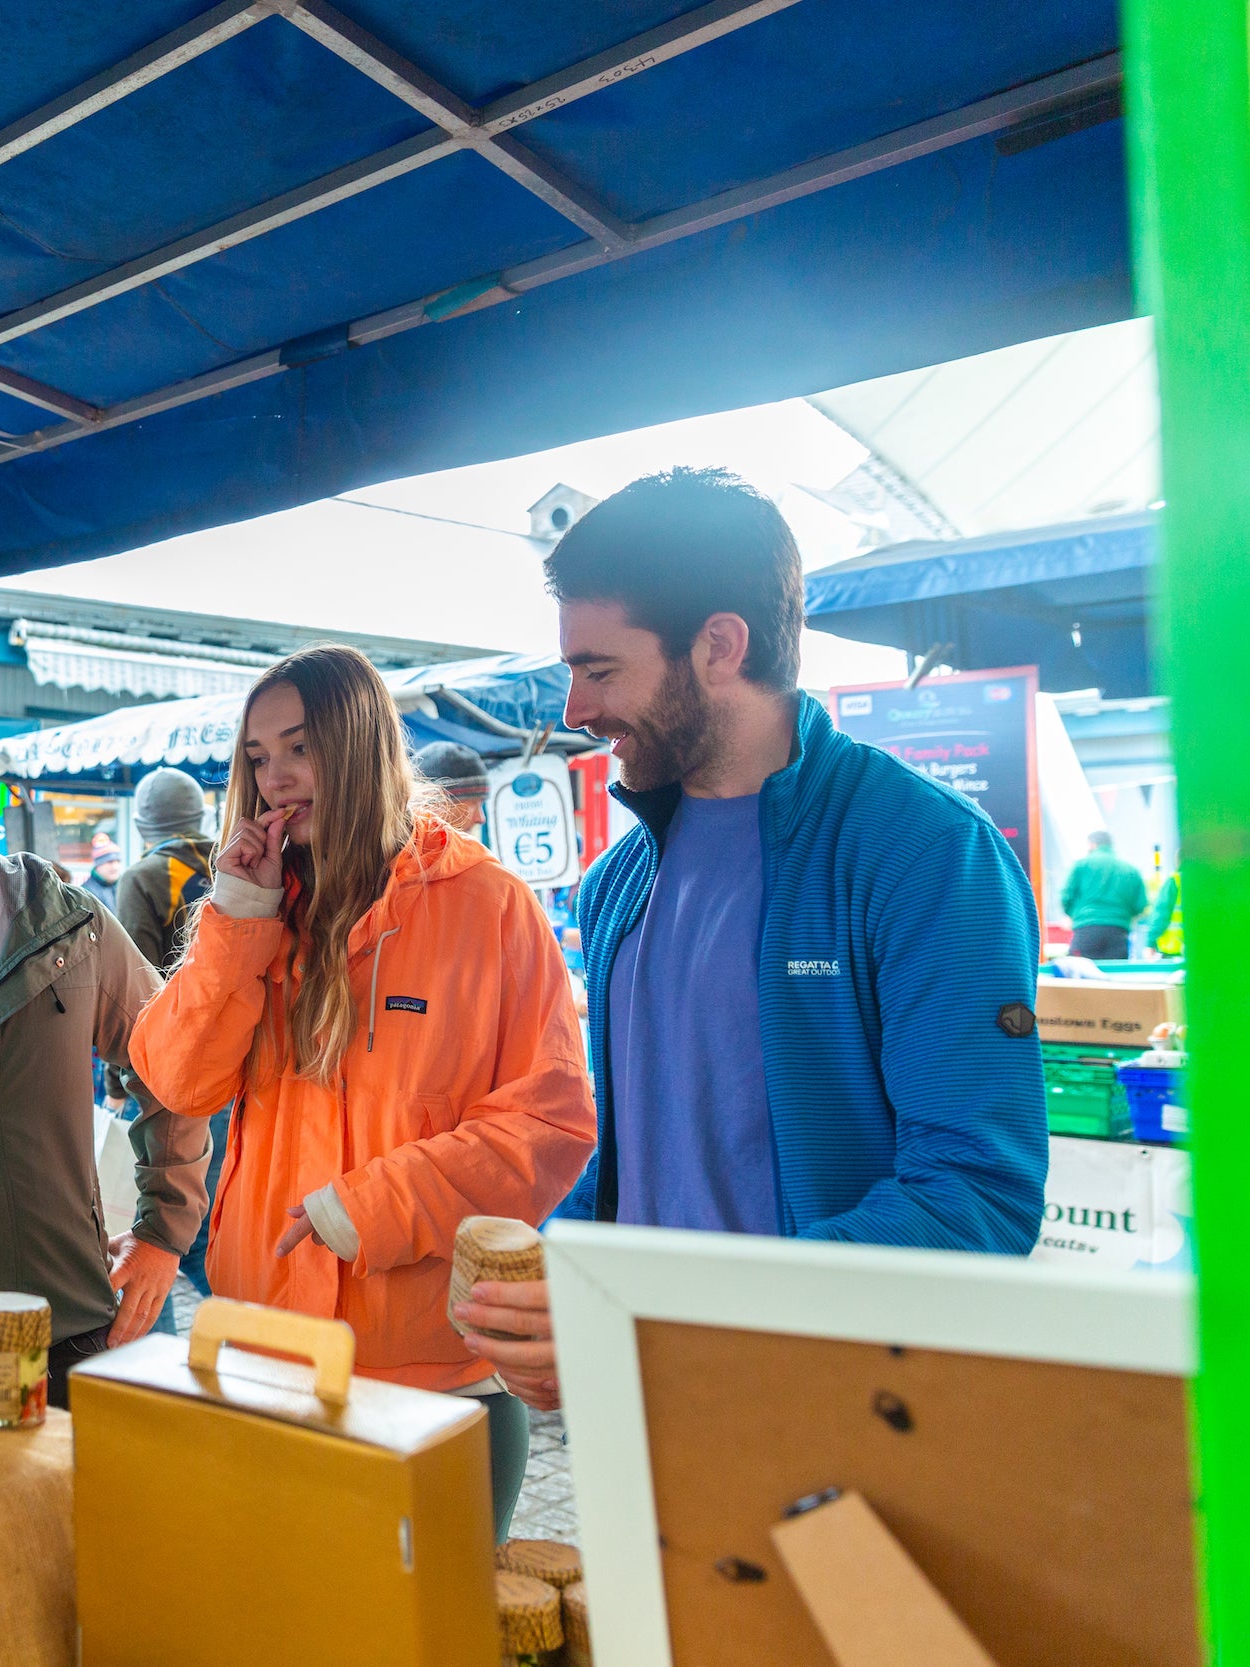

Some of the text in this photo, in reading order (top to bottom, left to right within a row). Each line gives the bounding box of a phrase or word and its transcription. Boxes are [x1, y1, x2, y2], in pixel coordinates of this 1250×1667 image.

[929, 762, 977, 778] Burgers
[514, 831, 553, 865] €5
[787, 960, 831, 969] REGATTA
[389, 1002, 420, 1010] patagonia
[1100, 1017, 1142, 1034] Eggs
[1038, 1234, 1086, 1251] eats
